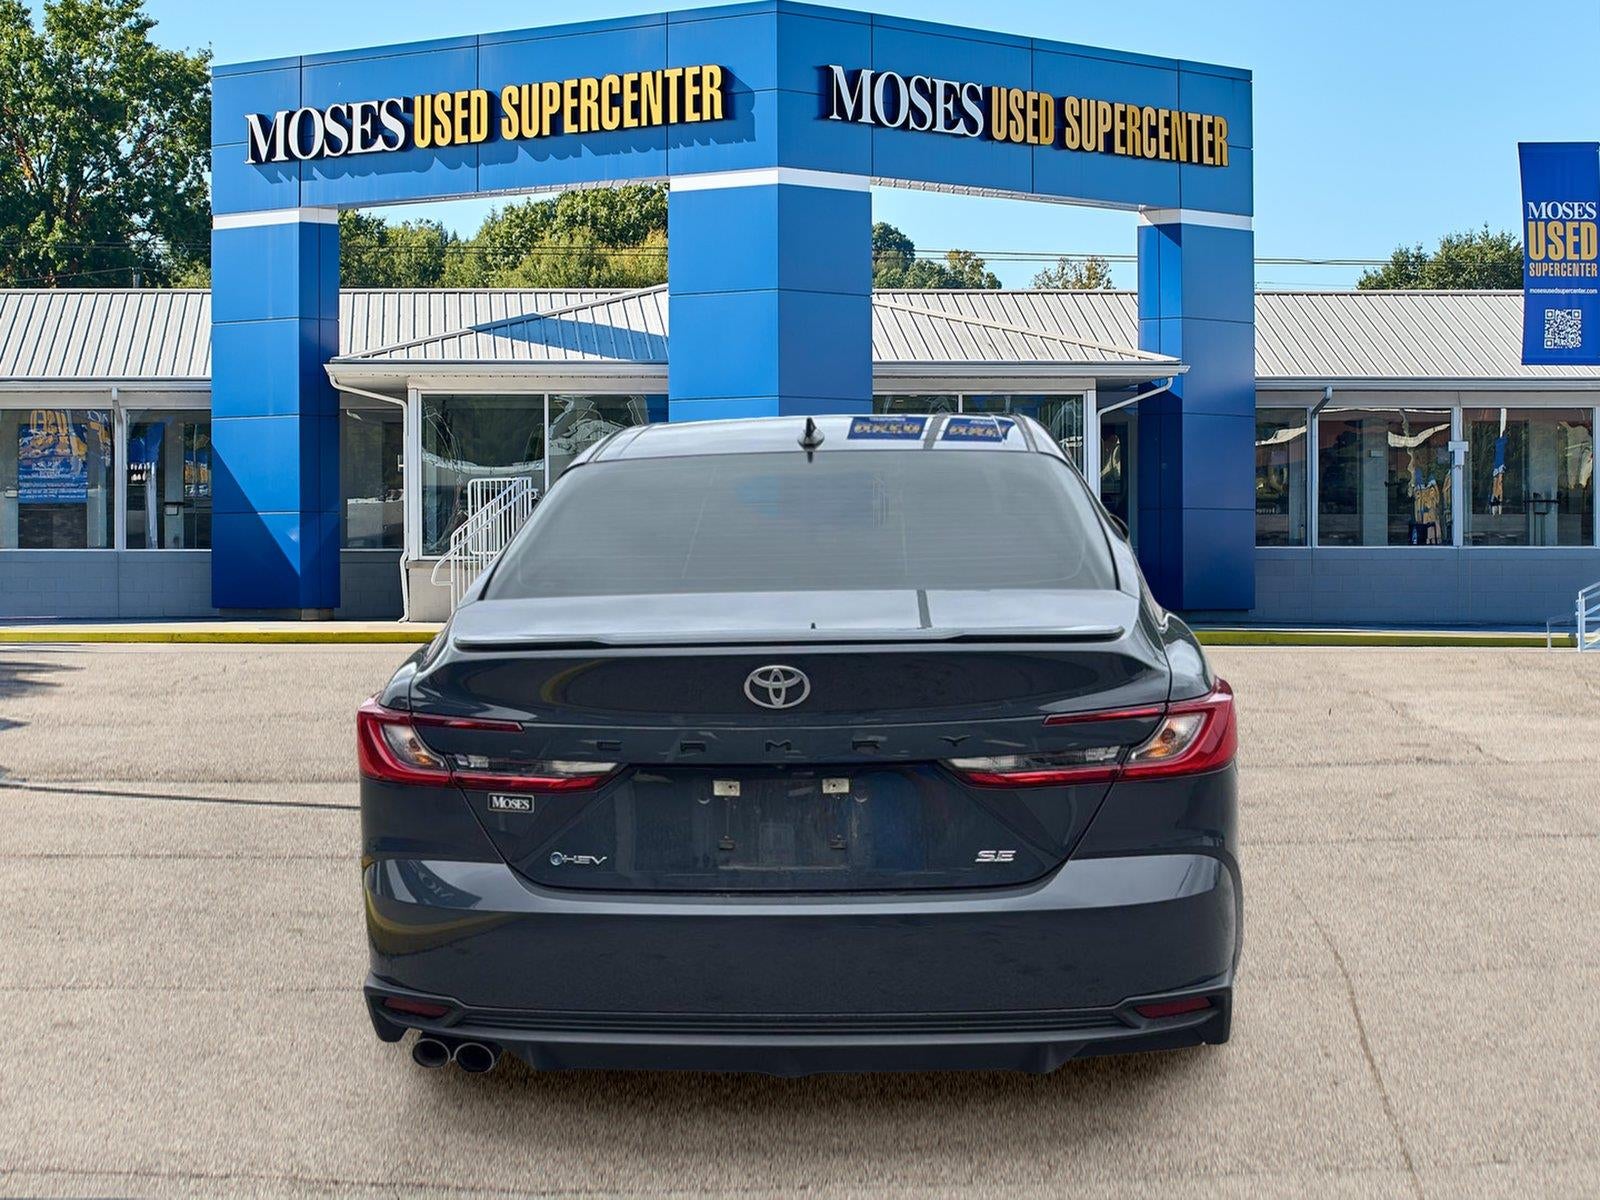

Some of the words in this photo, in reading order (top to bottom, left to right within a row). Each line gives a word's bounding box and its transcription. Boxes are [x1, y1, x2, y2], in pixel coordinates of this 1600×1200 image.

[243, 97, 406, 165] MOSES
[413, 88, 489, 149] USED
[500, 65, 724, 142] SUPERCENTER
[828, 64, 985, 138] MOSES
[990, 85, 1055, 146] USED
[1063, 94, 1230, 168] SUPERCENTER
[1527, 201, 1597, 219] MOSES
[1528, 221, 1598, 260] USED
[1529, 263, 1598, 277] SUPERCENTER
[1529, 287, 1598, 295] mosesusedsupercenter.com
[596, 734, 972, 752] CAMRY
[975, 850, 1016, 862] SE
